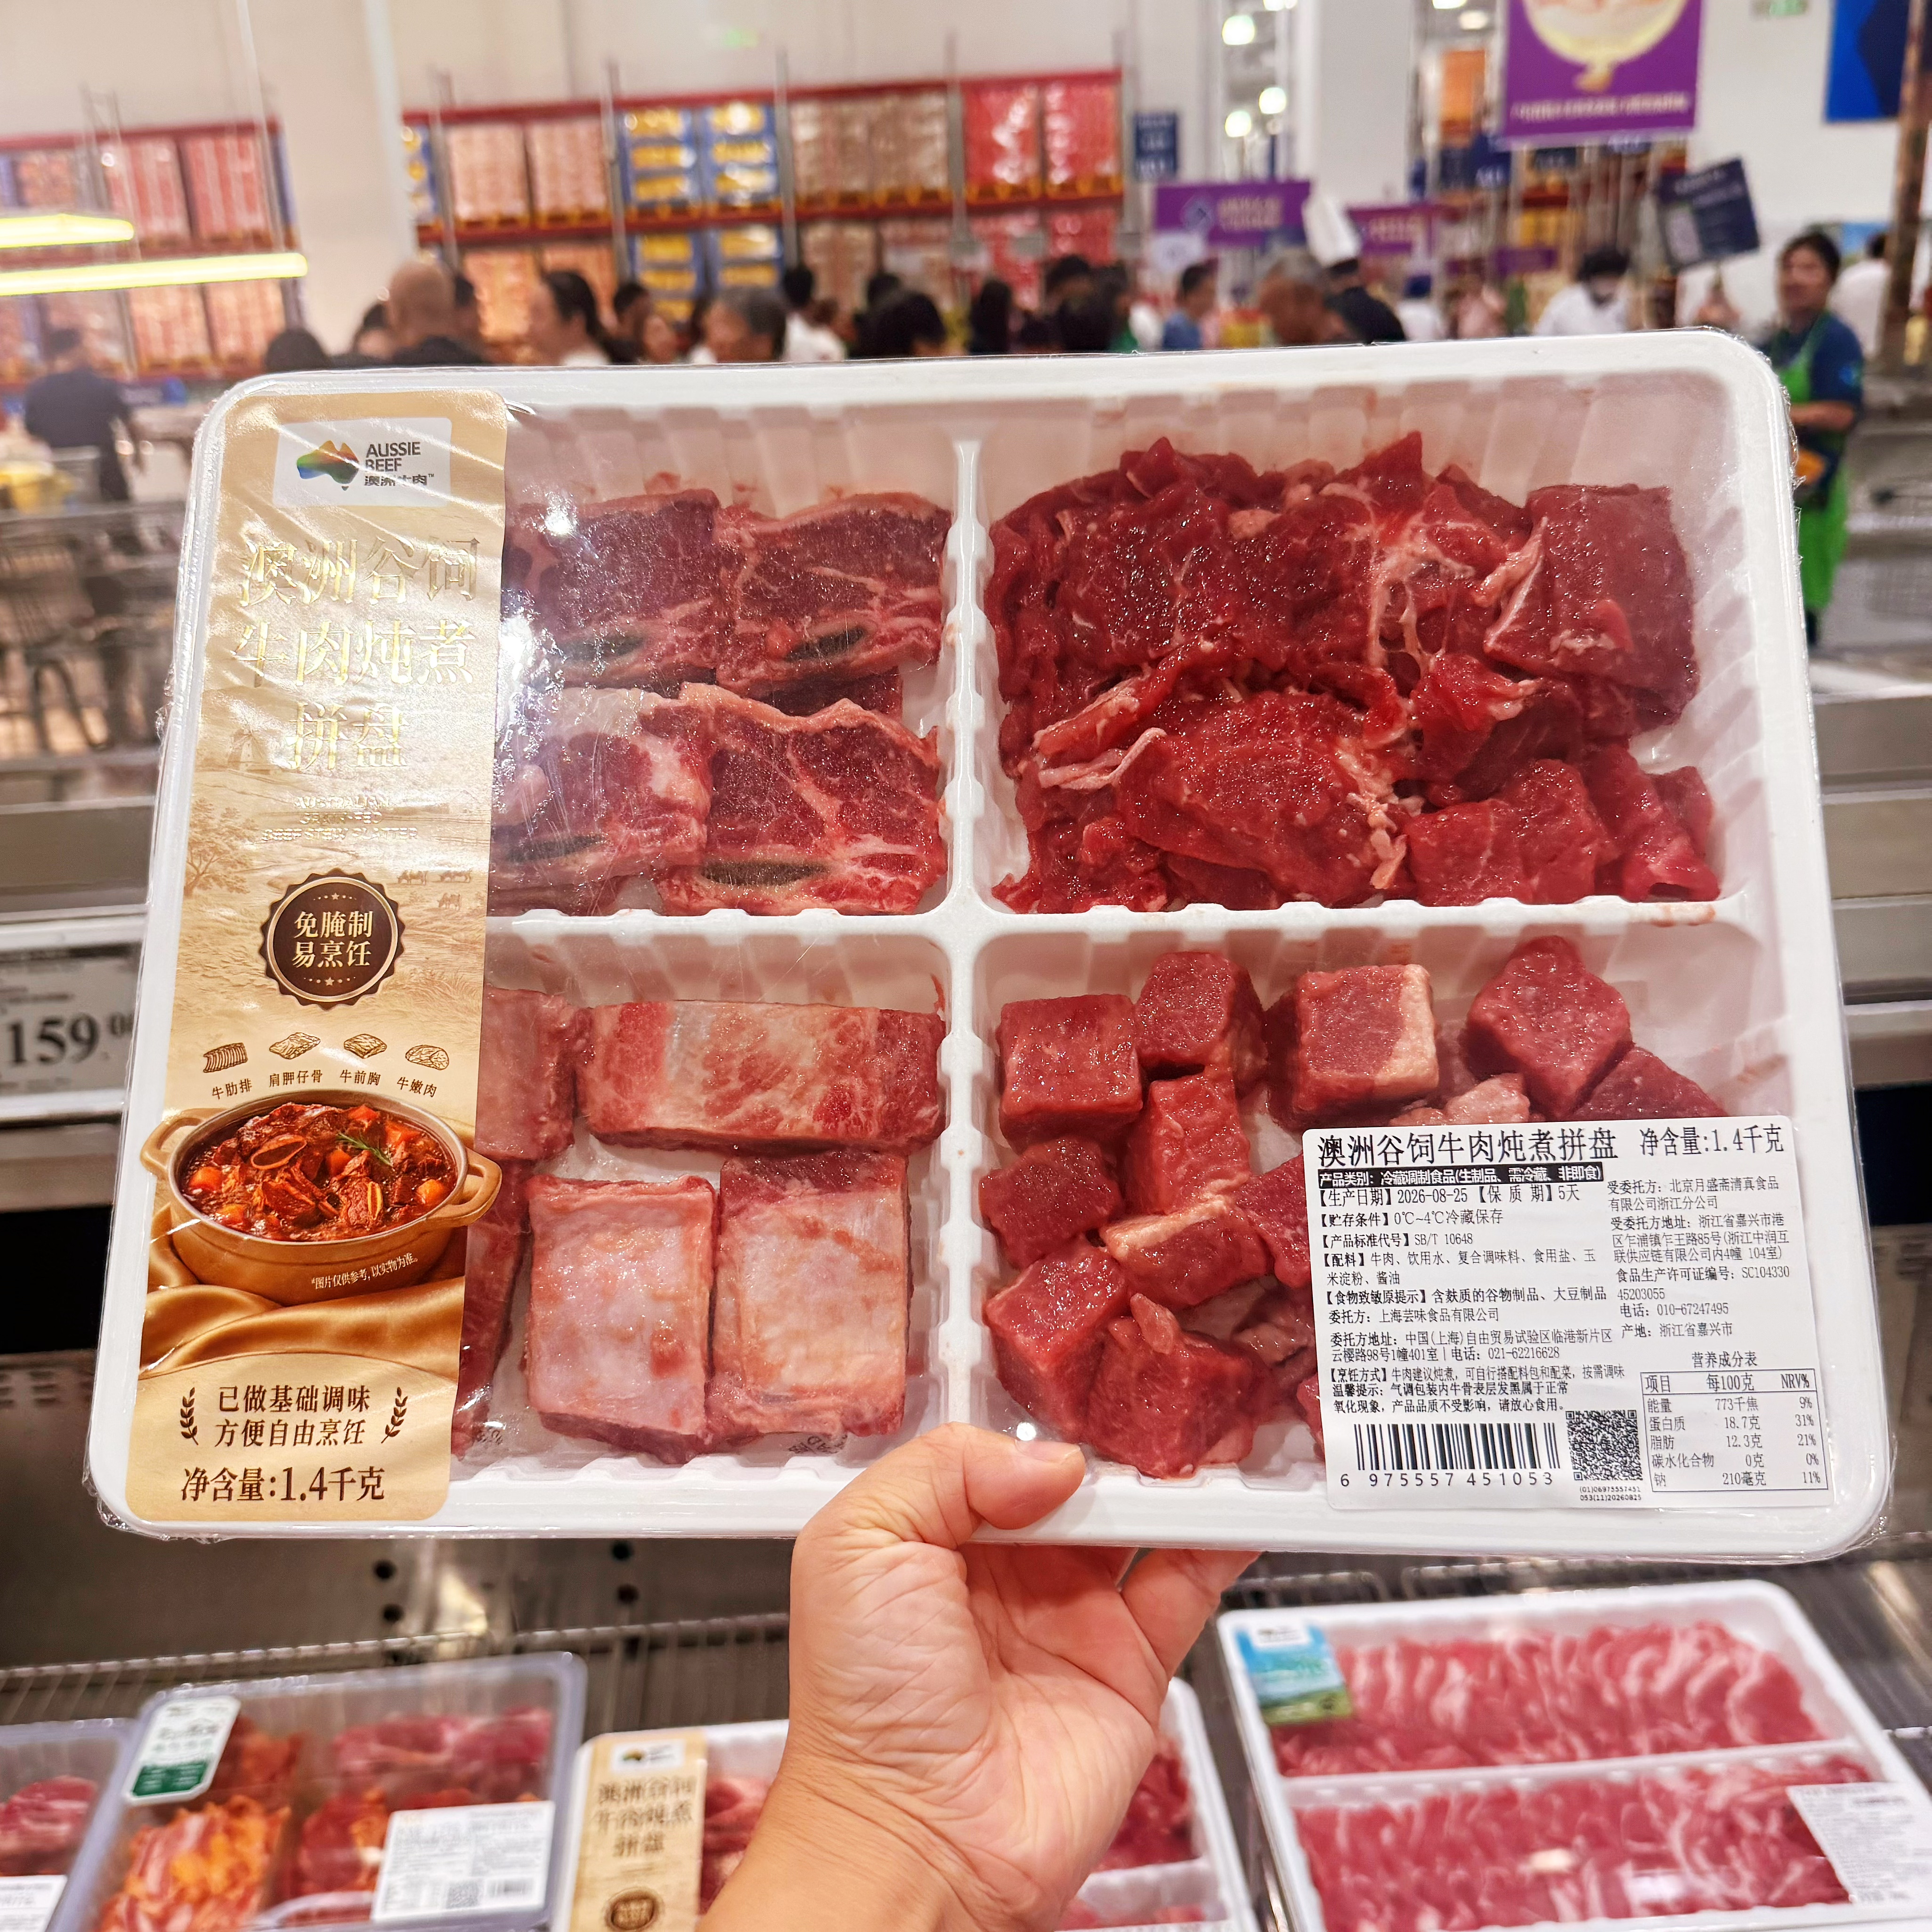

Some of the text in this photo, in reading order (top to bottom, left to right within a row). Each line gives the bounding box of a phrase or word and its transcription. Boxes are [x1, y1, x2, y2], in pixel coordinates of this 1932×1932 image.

[365, 441, 421, 458] AUSSIE
[365, 458, 402, 472] BEEF
[238, 536, 480, 607] 澳洲谷饲
[230, 619, 476, 688] 牛肉炖煮
[284, 702, 410, 770] 拼盘
[293, 911, 373, 938] 免腌制
[292, 940, 372, 968] 易烹饪
[211, 1069, 437, 1100] 牛肋排 肩胛仔骨 牛前胸 牛嫩肉
[1317, 1127, 1618, 1168] 澳洲谷饲牛肉炖煮拼盘
[1639, 1123, 1785, 1156] 净含量:1.4千克
[1608, 1195, 1718, 1211] 有限公司浙江分公司
[1327, 1271, 1400, 1286] 米淀粉、酱油
[1617, 1288, 1665, 1300] 45203055
[1692, 1350, 1759, 1368] 营养成分表
[1645, 1372, 1810, 1393] 项目 每100克 NRV%
[219, 1385, 371, 1413] 已做基础调味
[1648, 1396, 1813, 1413] 能量 773千焦 9%
[214, 1418, 366, 1447] 方便自由烹饪
[1649, 1414, 1814, 1432] 蛋白质 18.7克 31%
[1650, 1433, 1817, 1450] 脂肪 12.3克 21%
[1652, 1452, 1819, 1469] 碳水化合物 0克 0%
[181, 1466, 385, 1502] 净含量:1.4千克
[1654, 1471, 1821, 1487] 钠 210毫克 11%
